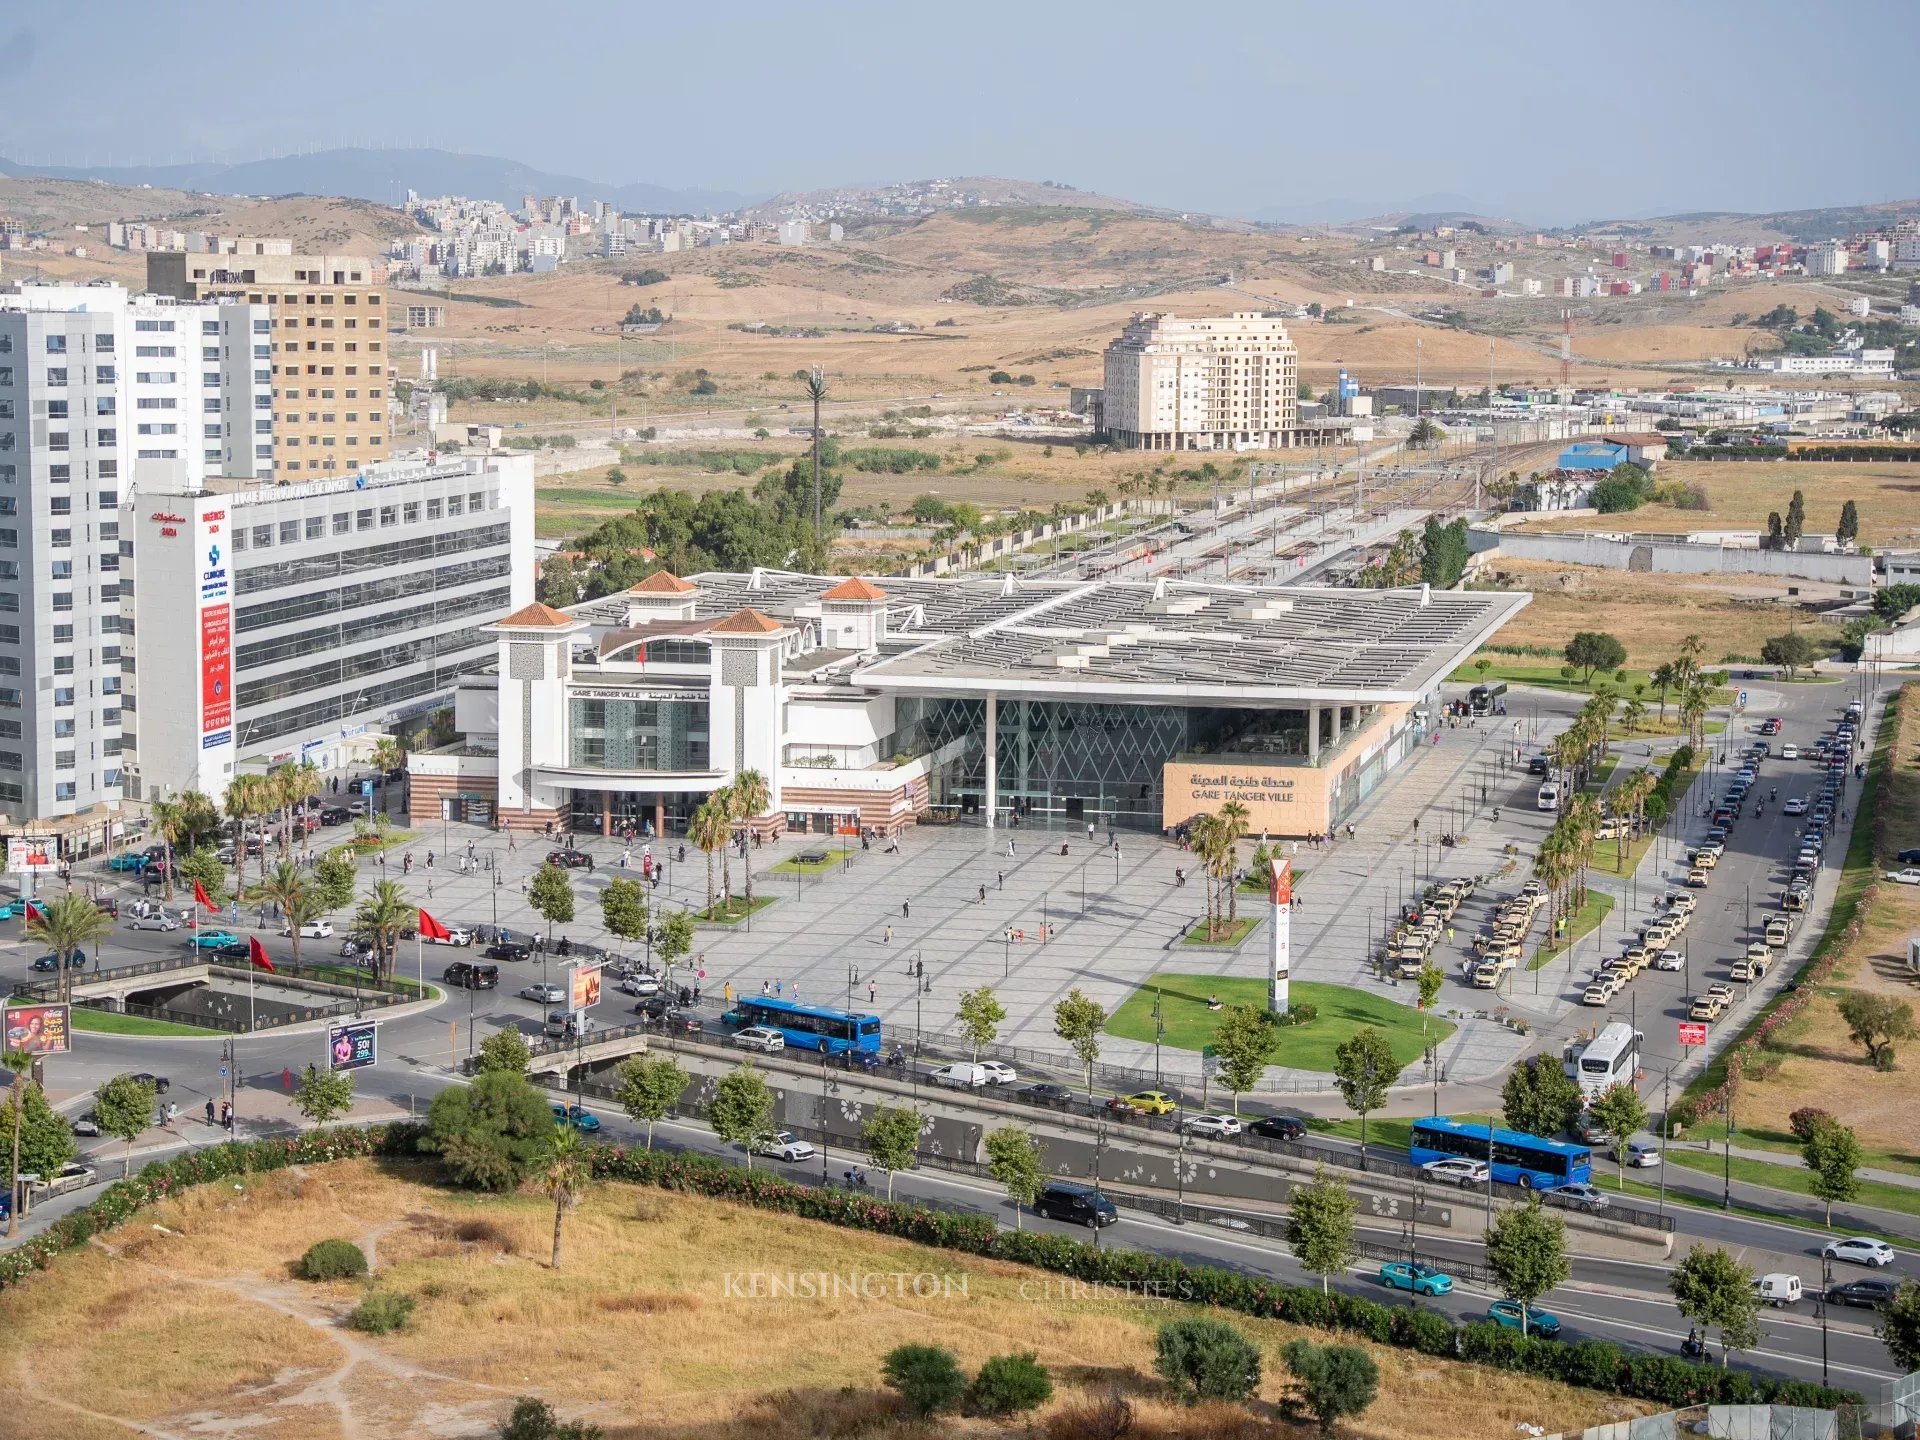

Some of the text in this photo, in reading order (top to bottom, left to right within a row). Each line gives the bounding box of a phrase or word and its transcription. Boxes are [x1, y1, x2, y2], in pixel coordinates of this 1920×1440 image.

[204, 569, 225, 580] CLINIQUE
[593, 690, 620, 698] TANGER
[1190, 774, 1294, 789] محطة طنجة المدينة
[1192, 790, 1294, 802] GARE TANGER VILLE
